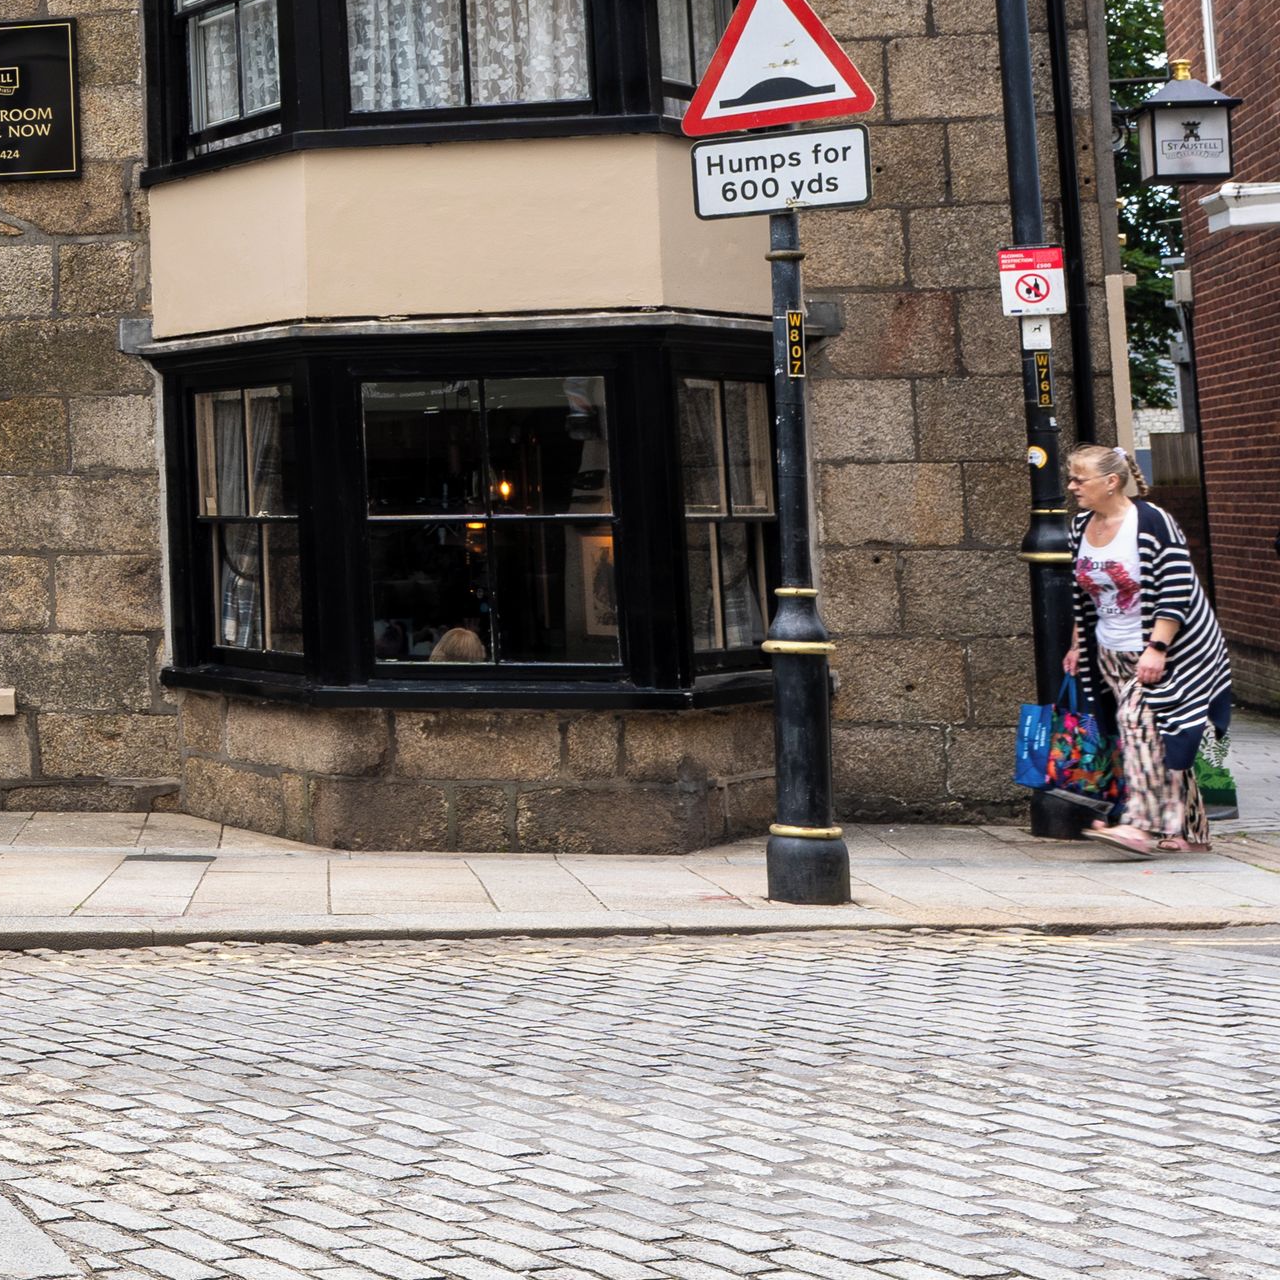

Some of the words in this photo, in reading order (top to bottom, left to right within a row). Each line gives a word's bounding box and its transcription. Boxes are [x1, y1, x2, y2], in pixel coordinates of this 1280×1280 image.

[0, 107, 53, 122] ROOM
[8, 123, 51, 138] NOW
[706, 152, 802, 176] Humps
[811, 143, 852, 165] for
[1179, 142, 1219, 151] AUSTELL
[721, 177, 780, 202] 600
[790, 172, 839, 199] yds
[788, 313, 802, 374] W807
[1037, 355, 1051, 405] W768
